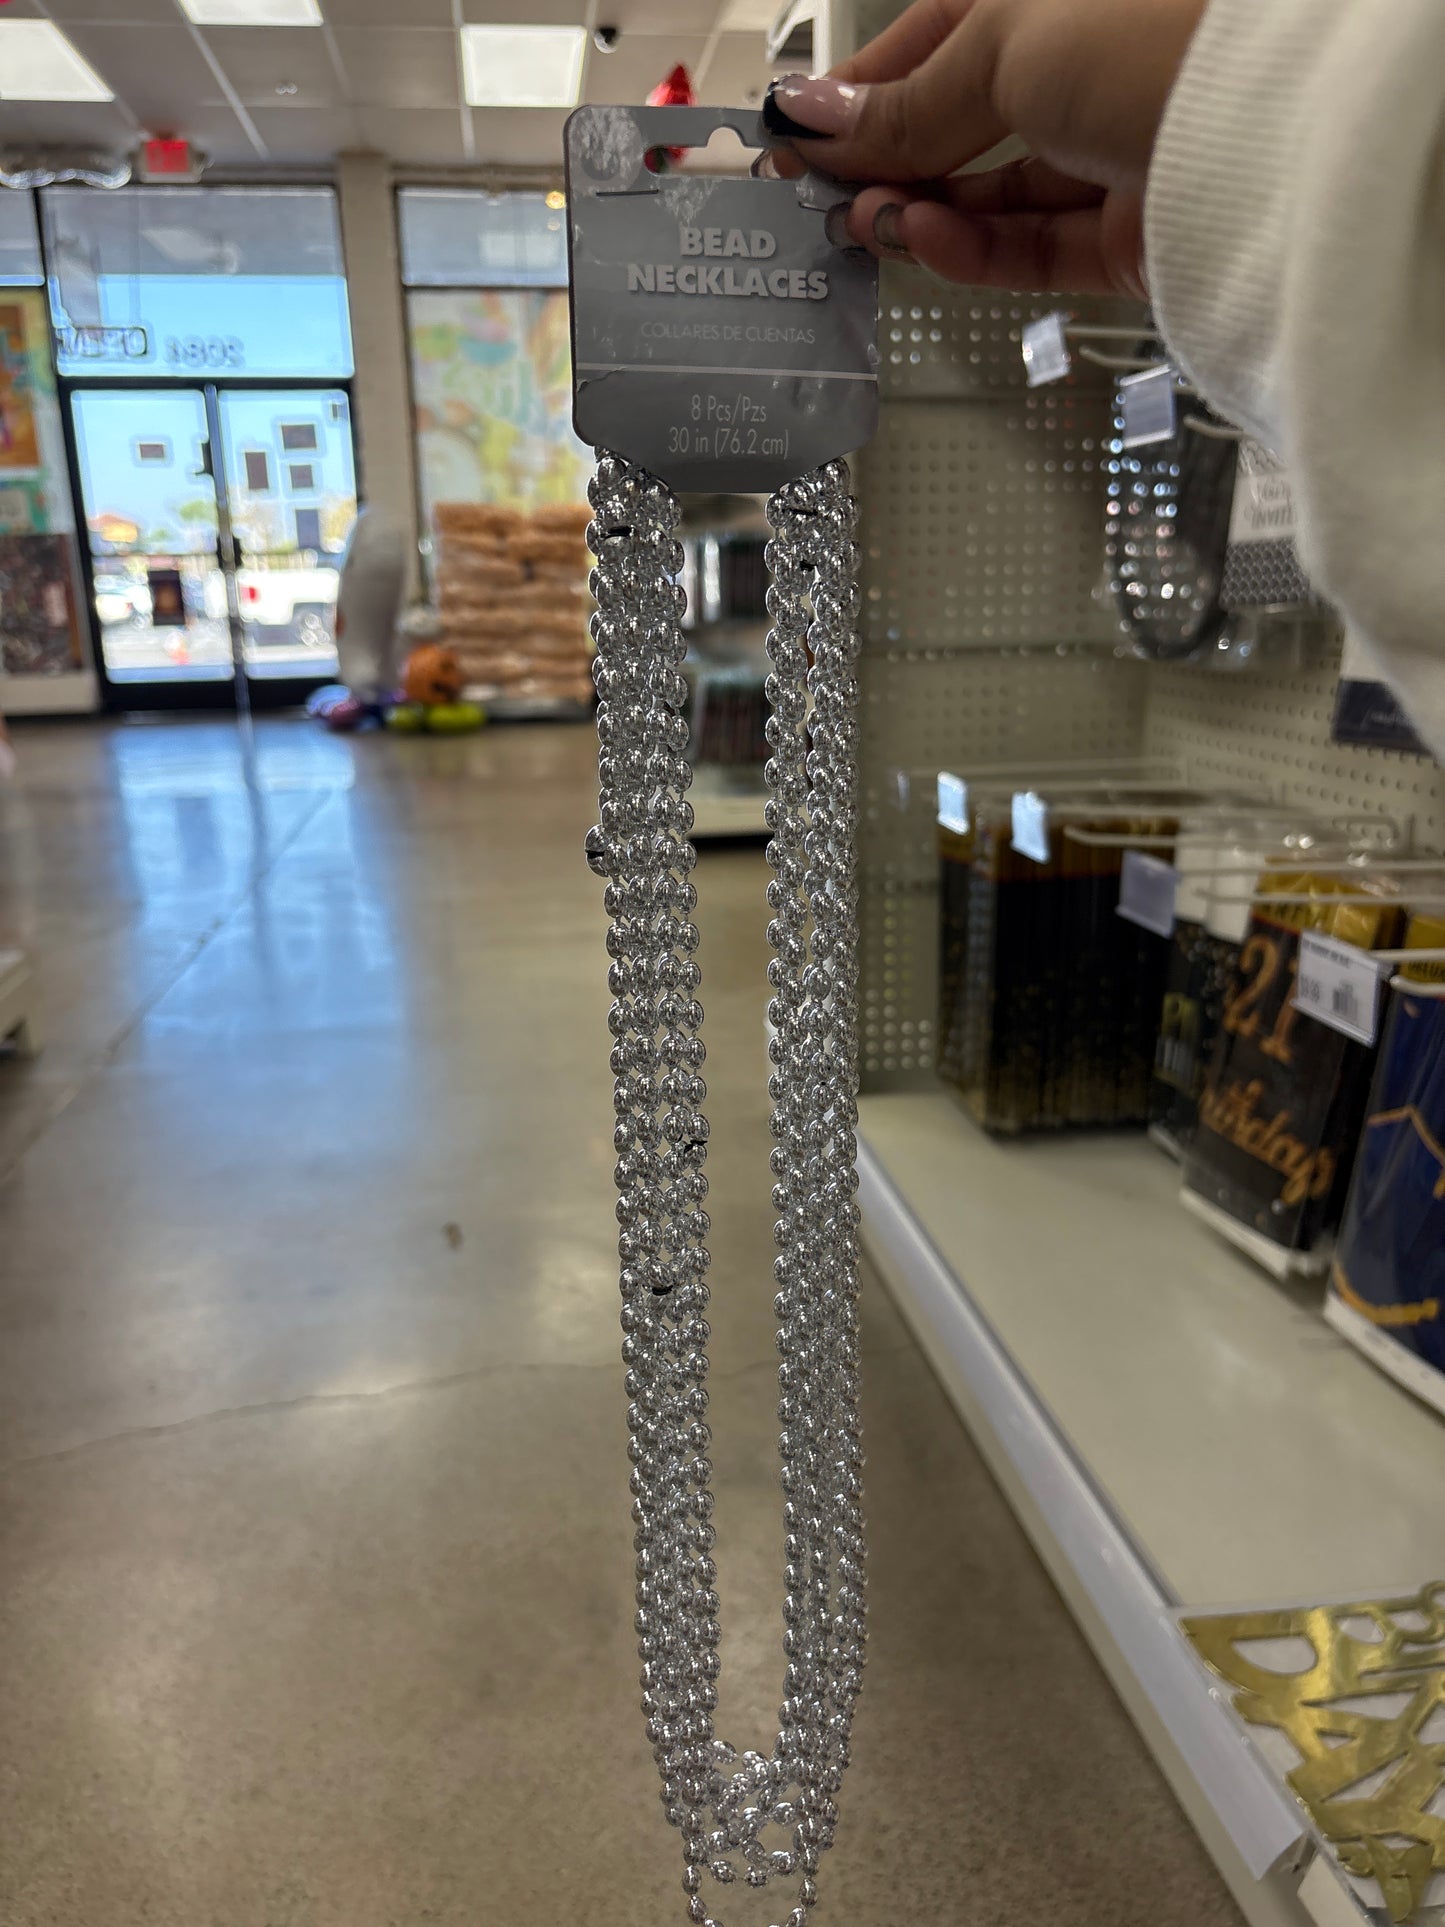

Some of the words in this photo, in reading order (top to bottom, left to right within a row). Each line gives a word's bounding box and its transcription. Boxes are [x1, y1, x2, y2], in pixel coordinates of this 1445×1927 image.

[680, 226, 777, 259] BEAD
[626, 263, 829, 300] NECKLACES
[640, 322, 721, 340] COLLARES
[723, 327, 743, 341] DE
[745, 327, 816, 344] CUENTAS
[691, 394, 702, 421] 8
[707, 393, 768, 425] Pcs/Pzs
[668, 427, 690, 453] 30
[695, 428, 709, 453] in
[714, 427, 757, 459] (76.2
[761, 429, 789, 460] cm)
